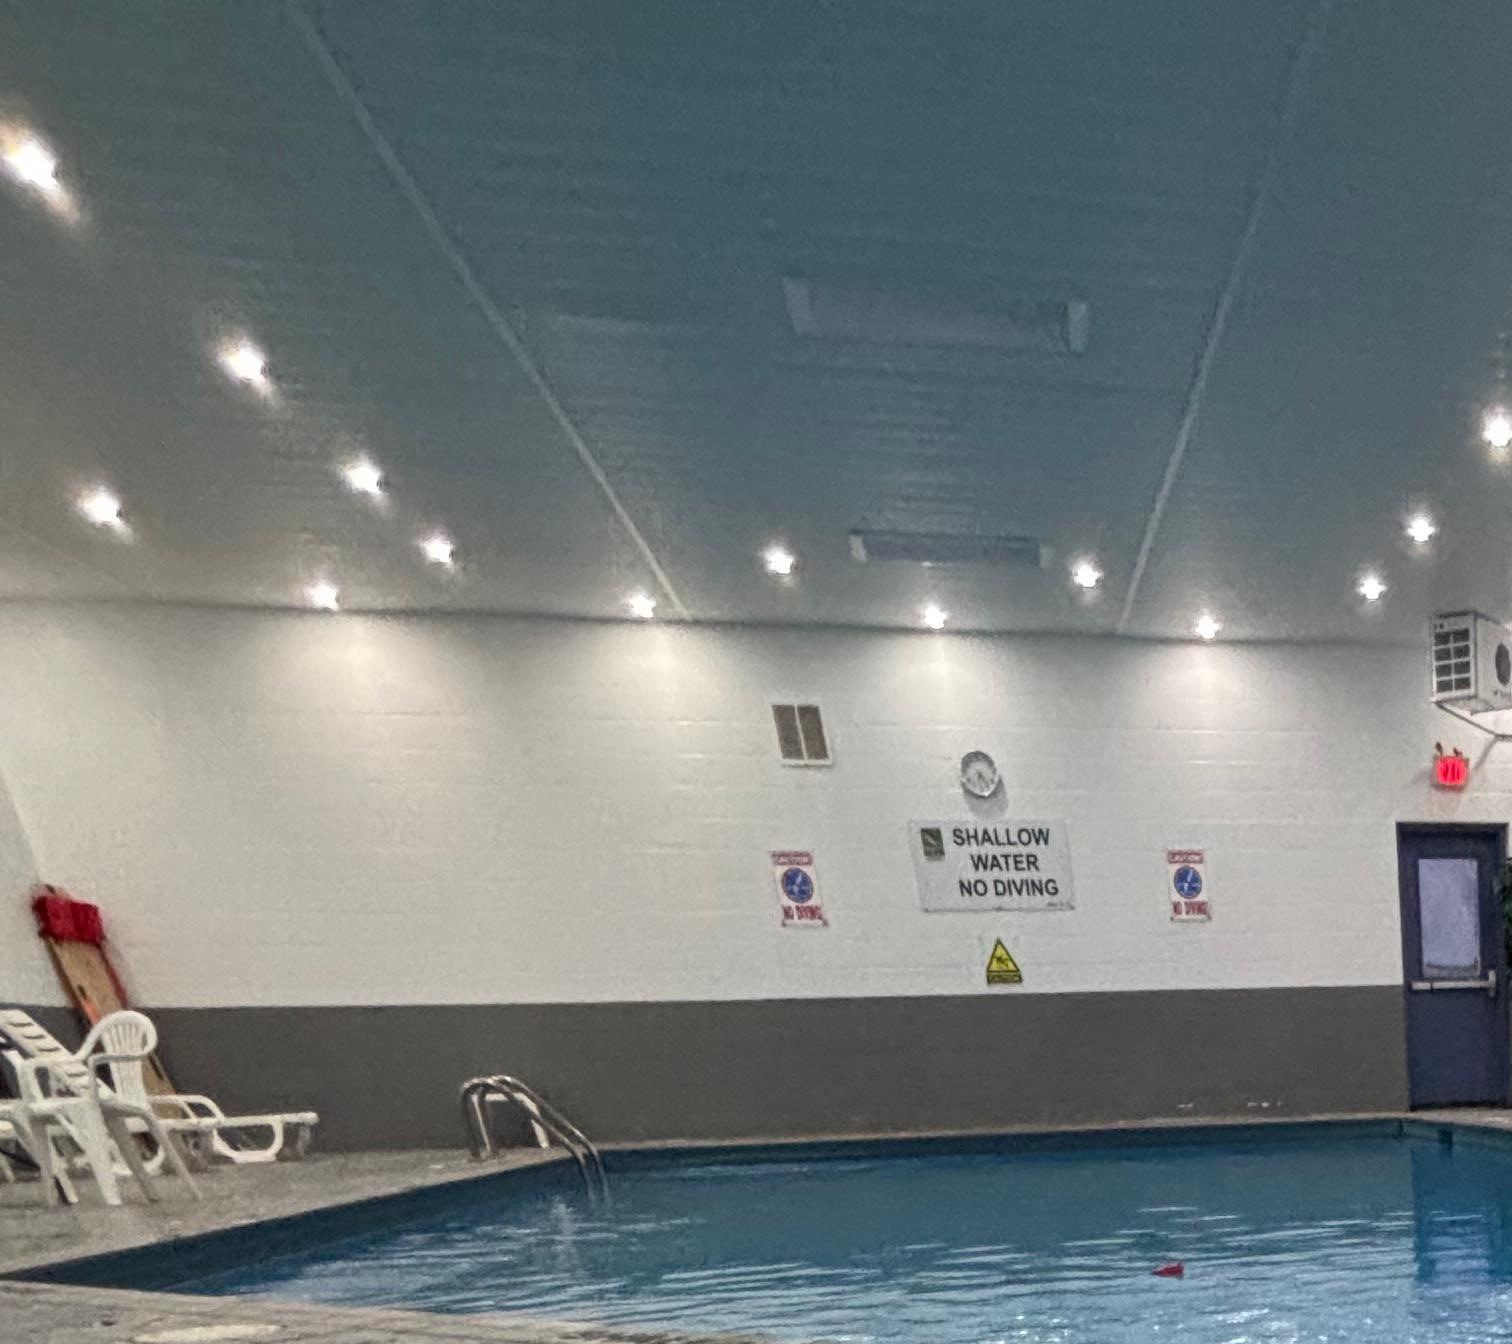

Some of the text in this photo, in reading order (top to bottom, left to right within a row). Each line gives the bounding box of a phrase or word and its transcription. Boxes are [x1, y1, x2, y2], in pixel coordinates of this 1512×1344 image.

[953, 828, 1050, 847] SHALLOW
[971, 854, 1040, 872] WATER
[959, 879, 1059, 897] NO DIVING
